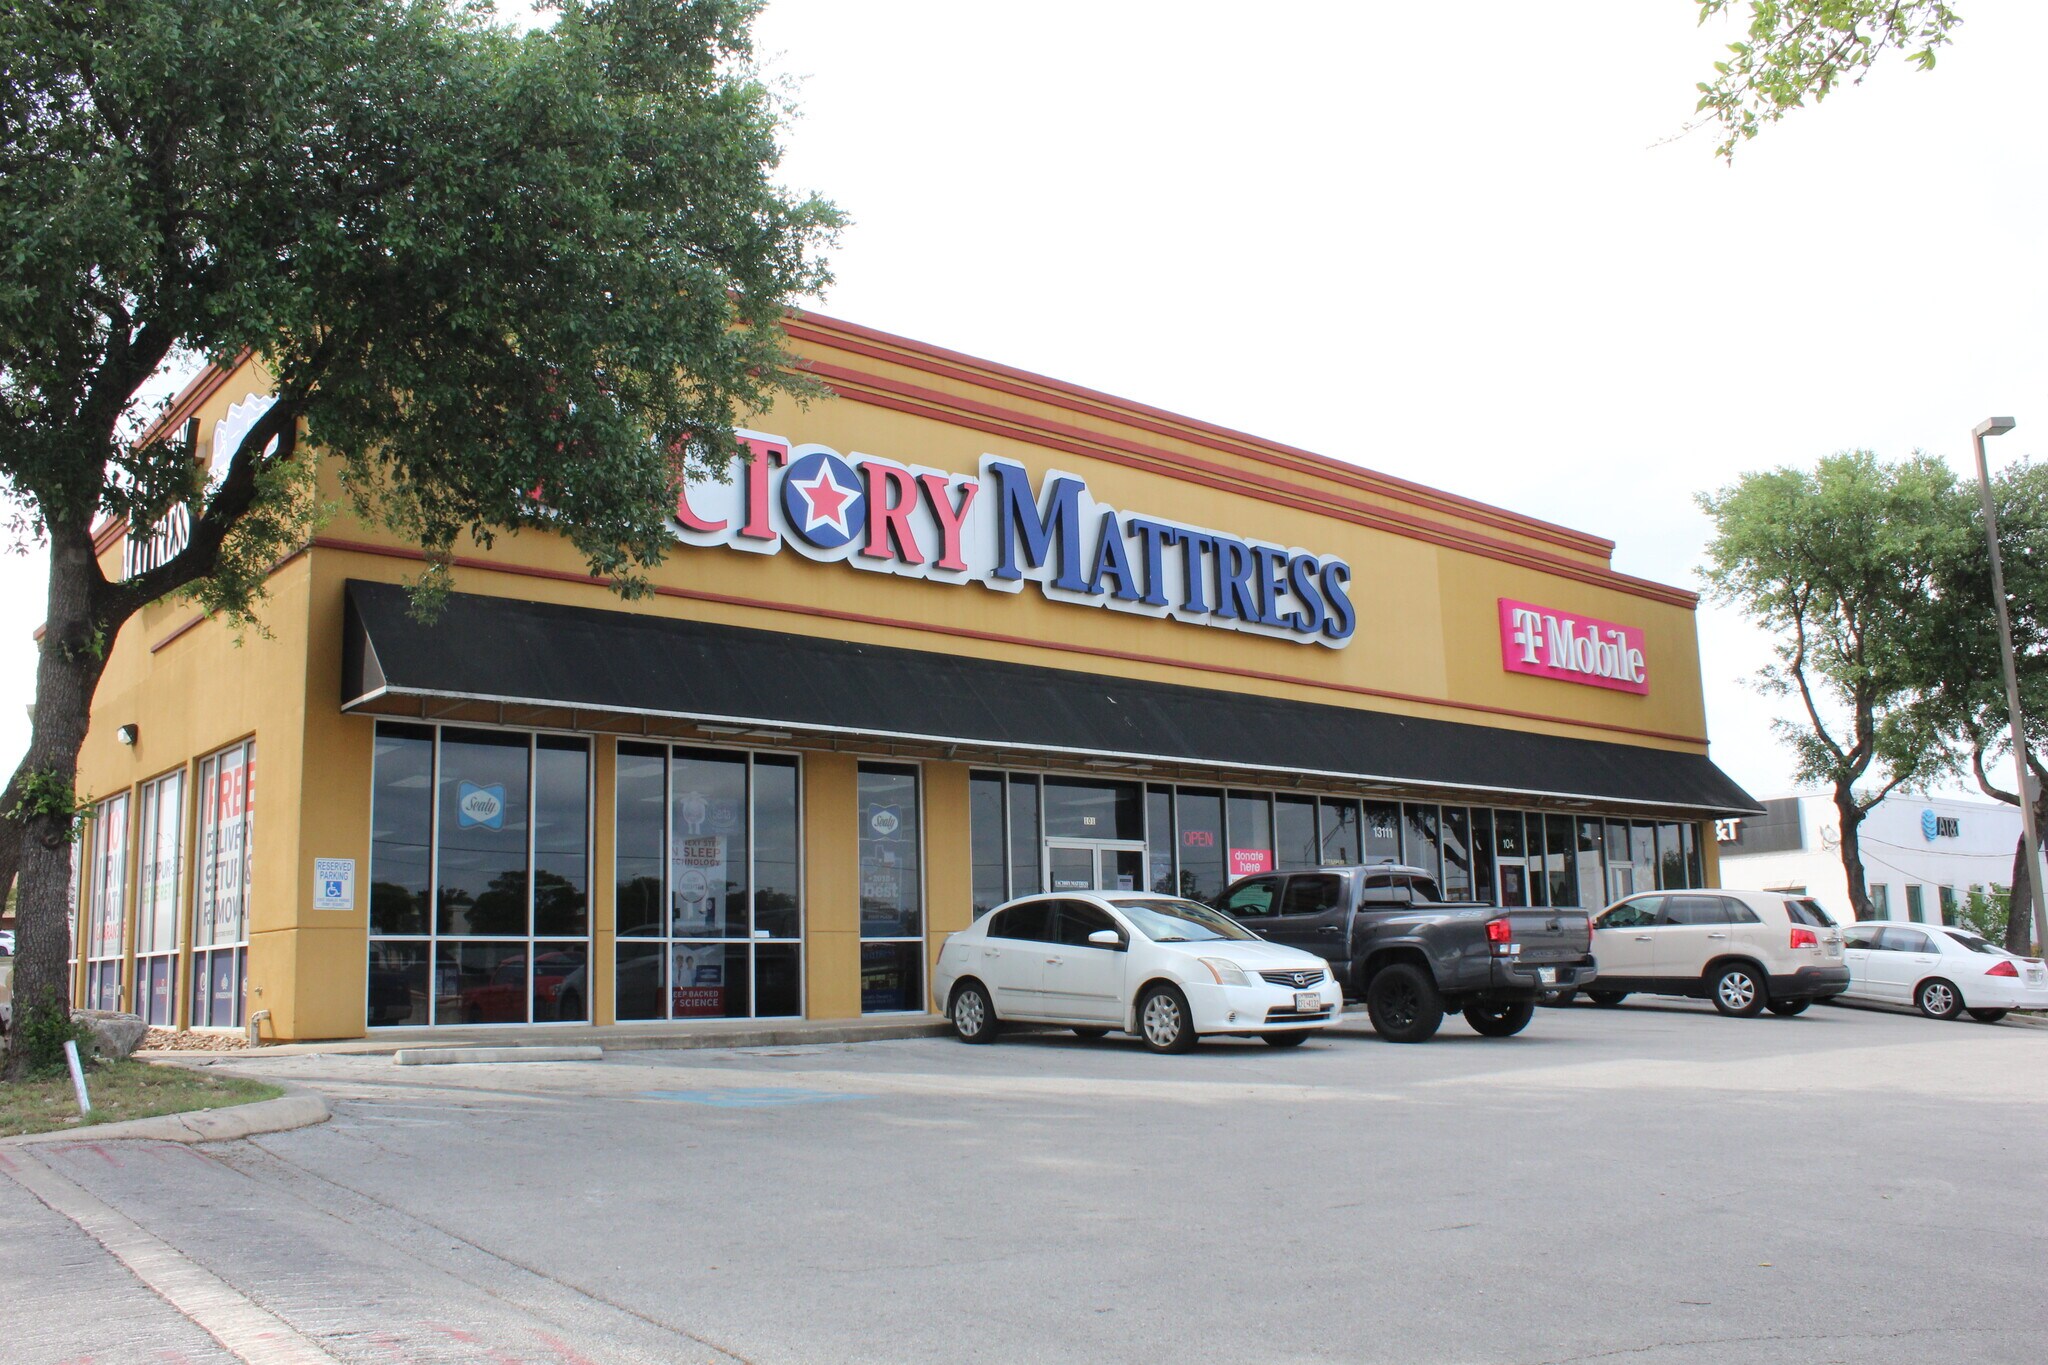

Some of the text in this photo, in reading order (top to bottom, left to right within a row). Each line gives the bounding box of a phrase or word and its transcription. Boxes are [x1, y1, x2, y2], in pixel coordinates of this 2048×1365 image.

[988, 462, 1356, 640] MATTRESS
[208, 762, 255, 825] FREE
[466, 796, 496, 816] Sealy
[875, 814, 895, 831] Sealy
[1939, 816, 1960, 838] AT&T
[1373, 827, 1393, 838] 13111
[1183, 831, 1214, 847] OPEN
[1502, 838, 1514, 849] 104
[683, 846, 721, 858] SLEEP
[1234, 850, 1264, 861] donate
[318, 861, 352, 872] RESERVED
[671, 858, 720, 867] ECHNOLOGY
[1240, 861, 1260, 872] here
[320, 870, 348, 880] PARKING
[864, 882, 898, 898] best
[680, 999, 718, 1007] SCIENCE
